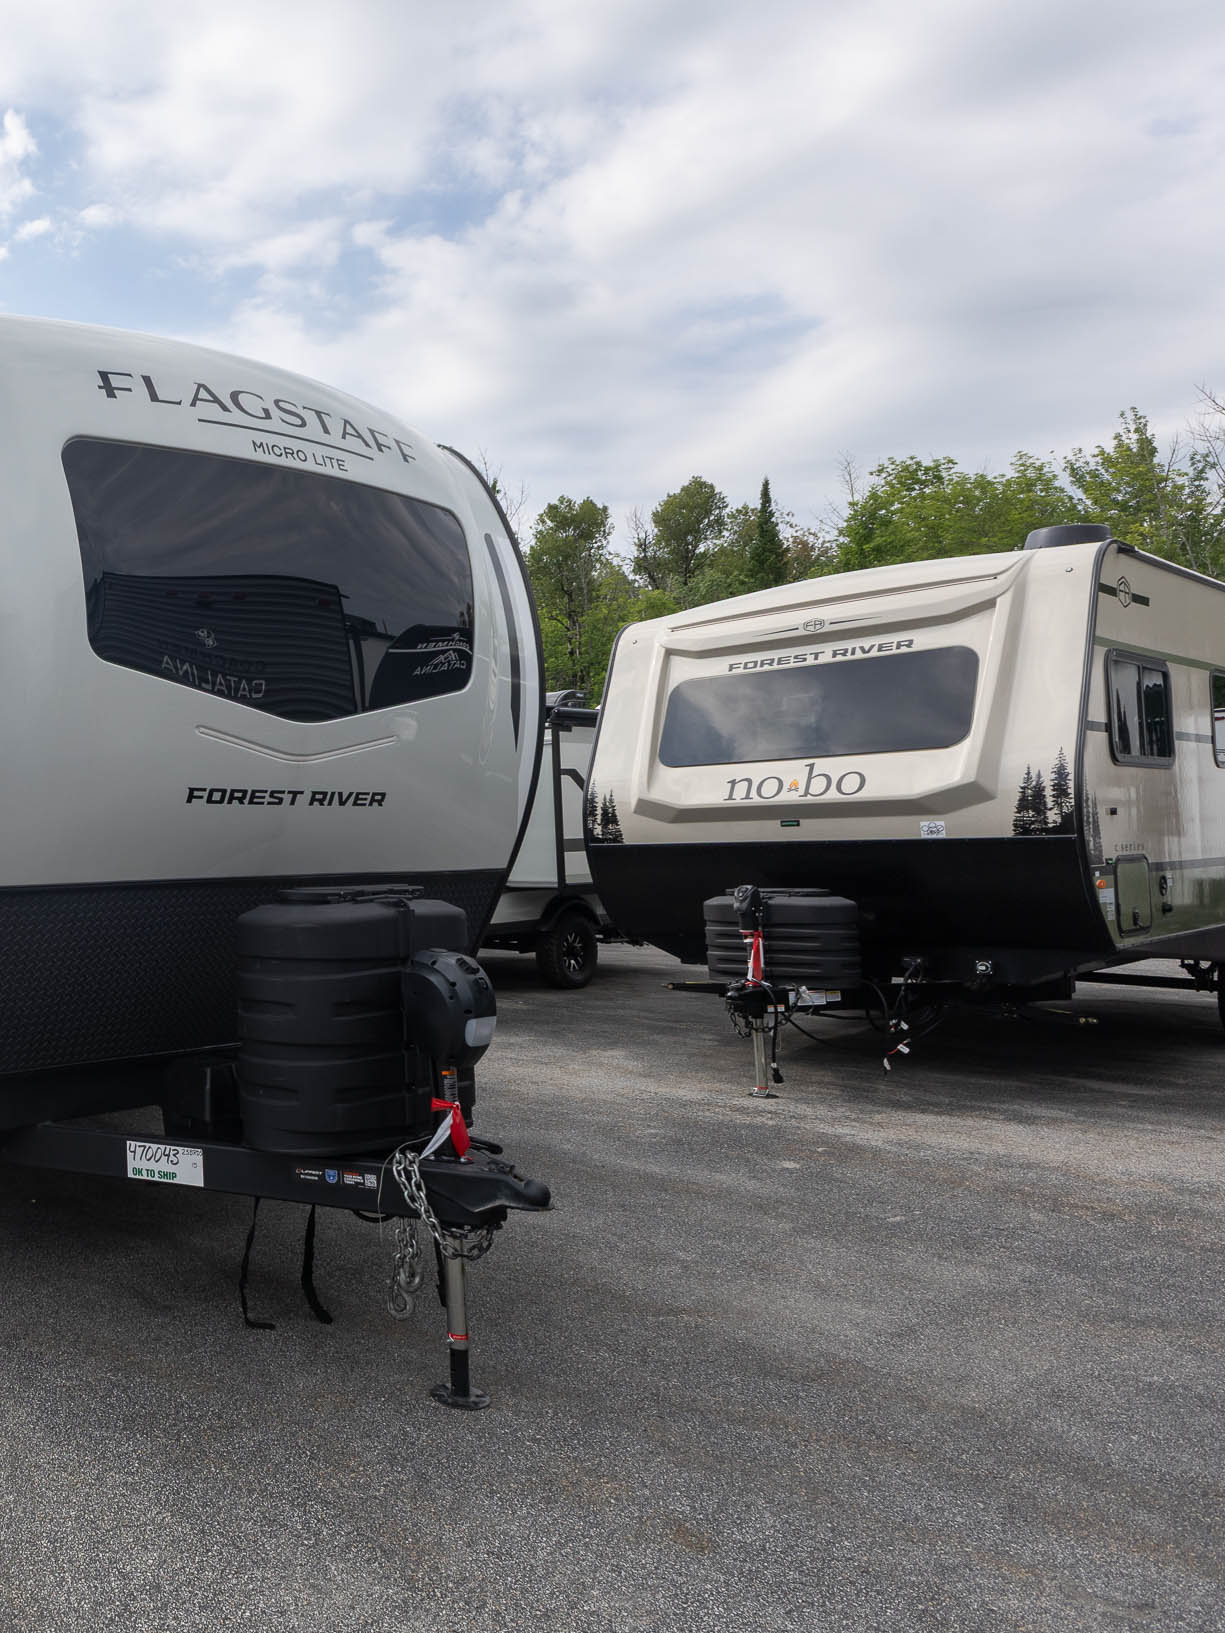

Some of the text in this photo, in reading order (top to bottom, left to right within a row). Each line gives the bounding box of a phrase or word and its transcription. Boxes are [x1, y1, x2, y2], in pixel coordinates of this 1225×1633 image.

[97, 369, 417, 464] FLAGSTAFF
[251, 440, 349, 472] MICRO LITE
[728, 639, 915, 672] FOREST RIVER
[186, 787, 387, 807] FOREST RIVER
[128, 1142, 180, 1166] 470043
[132, 1167, 177, 1181] OK TO SHIP
